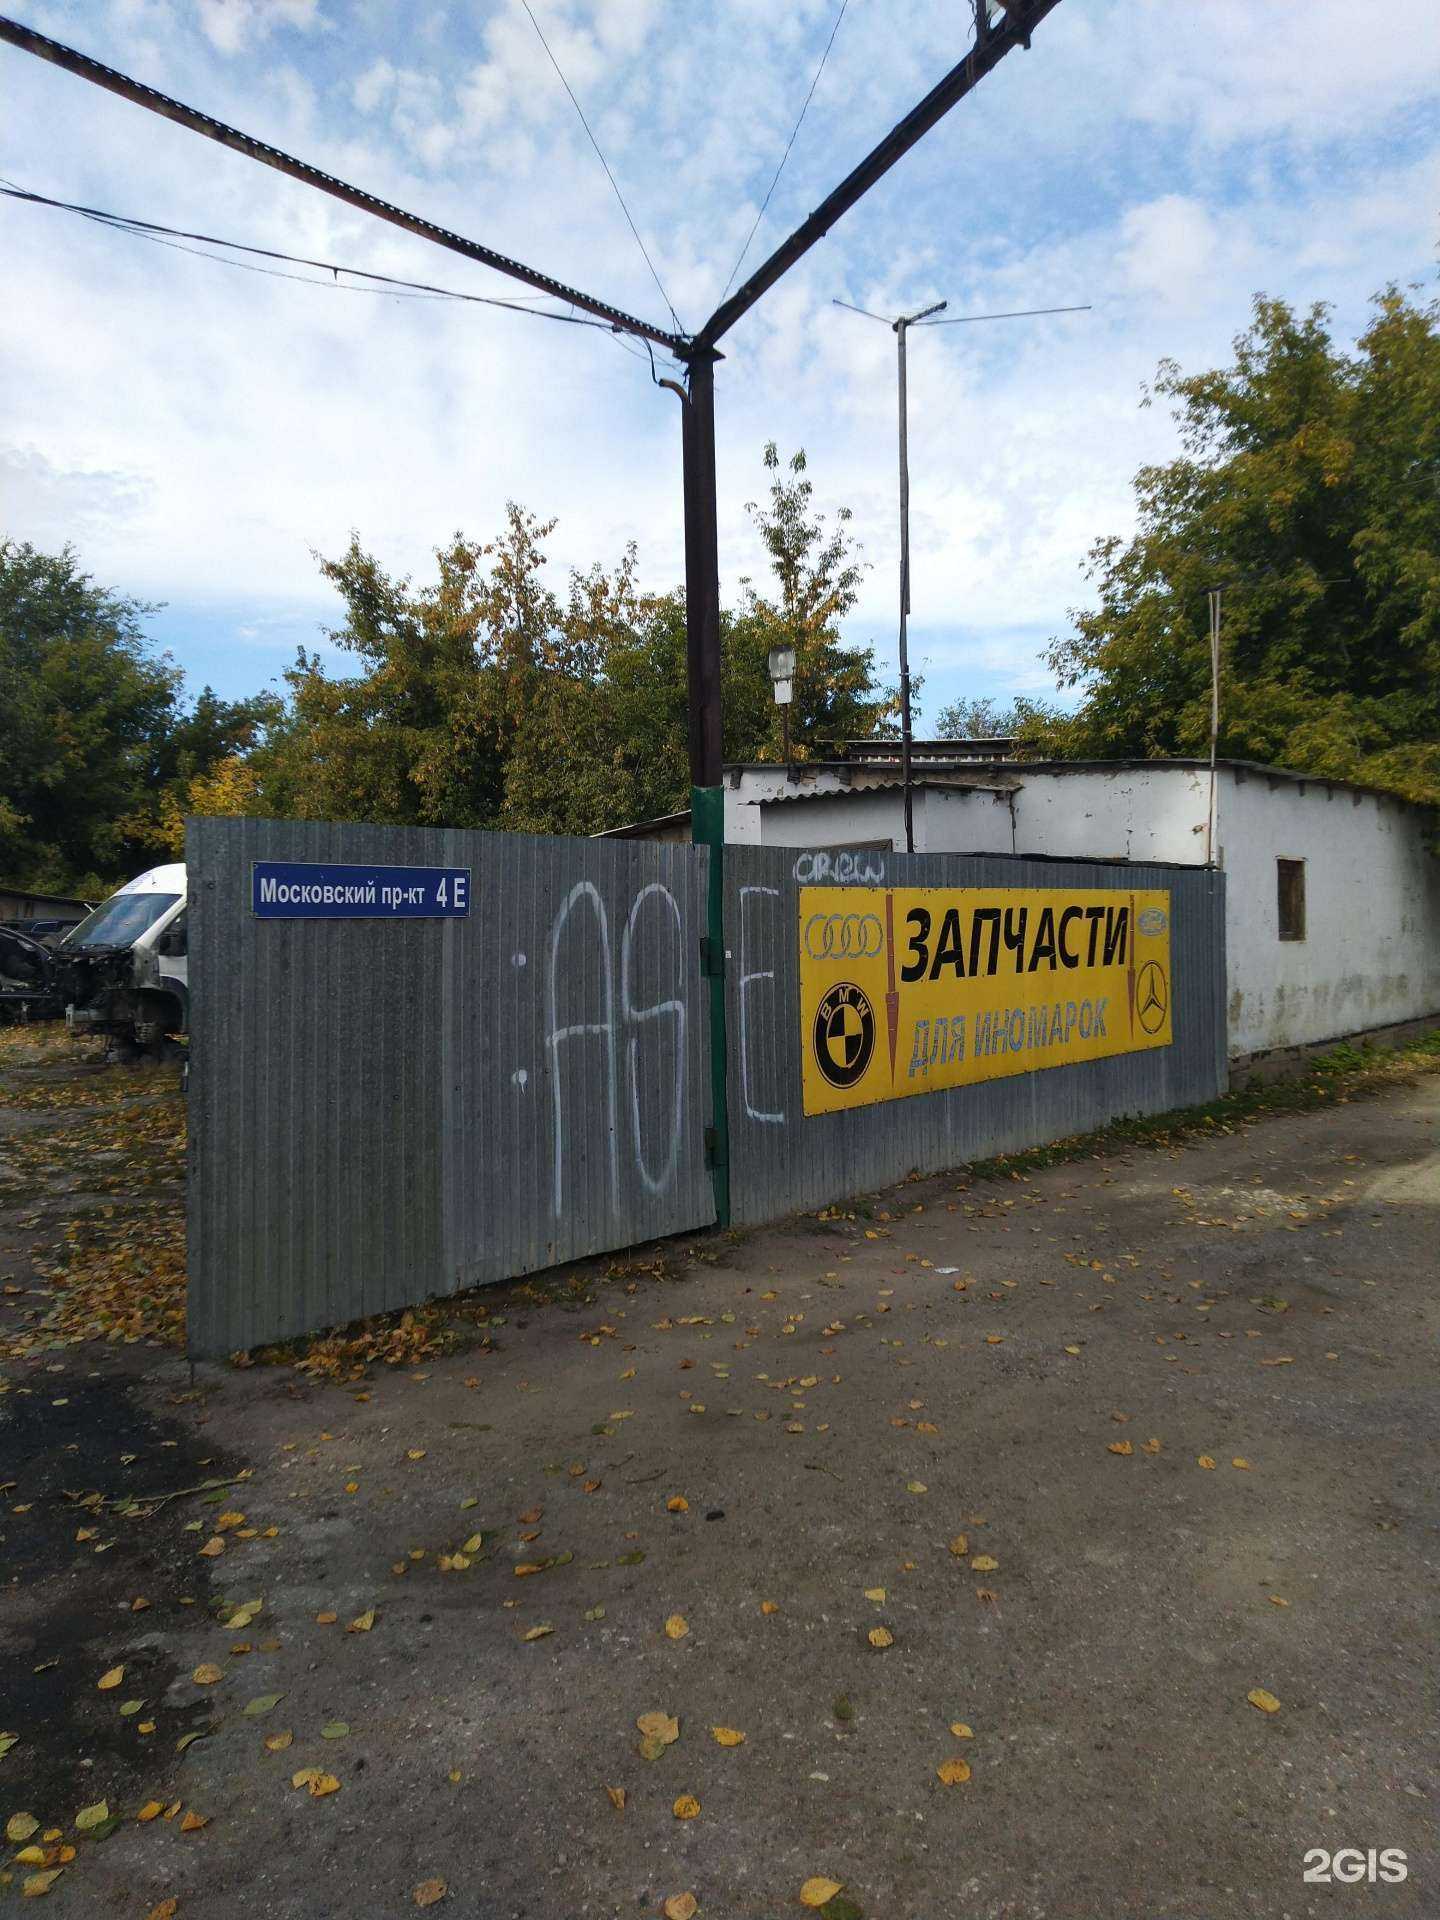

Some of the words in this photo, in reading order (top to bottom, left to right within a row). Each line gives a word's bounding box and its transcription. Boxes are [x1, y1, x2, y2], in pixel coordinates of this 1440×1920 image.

[260, 877, 376, 904] Московский
[381, 886, 425, 910] пр-кт
[900, 905, 1129, 983] ЗАПЧАСТИ
[820, 986, 870, 1021] BMW
[908, 1014, 966, 1078] ДЛЯ
[974, 996, 1109, 1057] ИНОМАРОК
